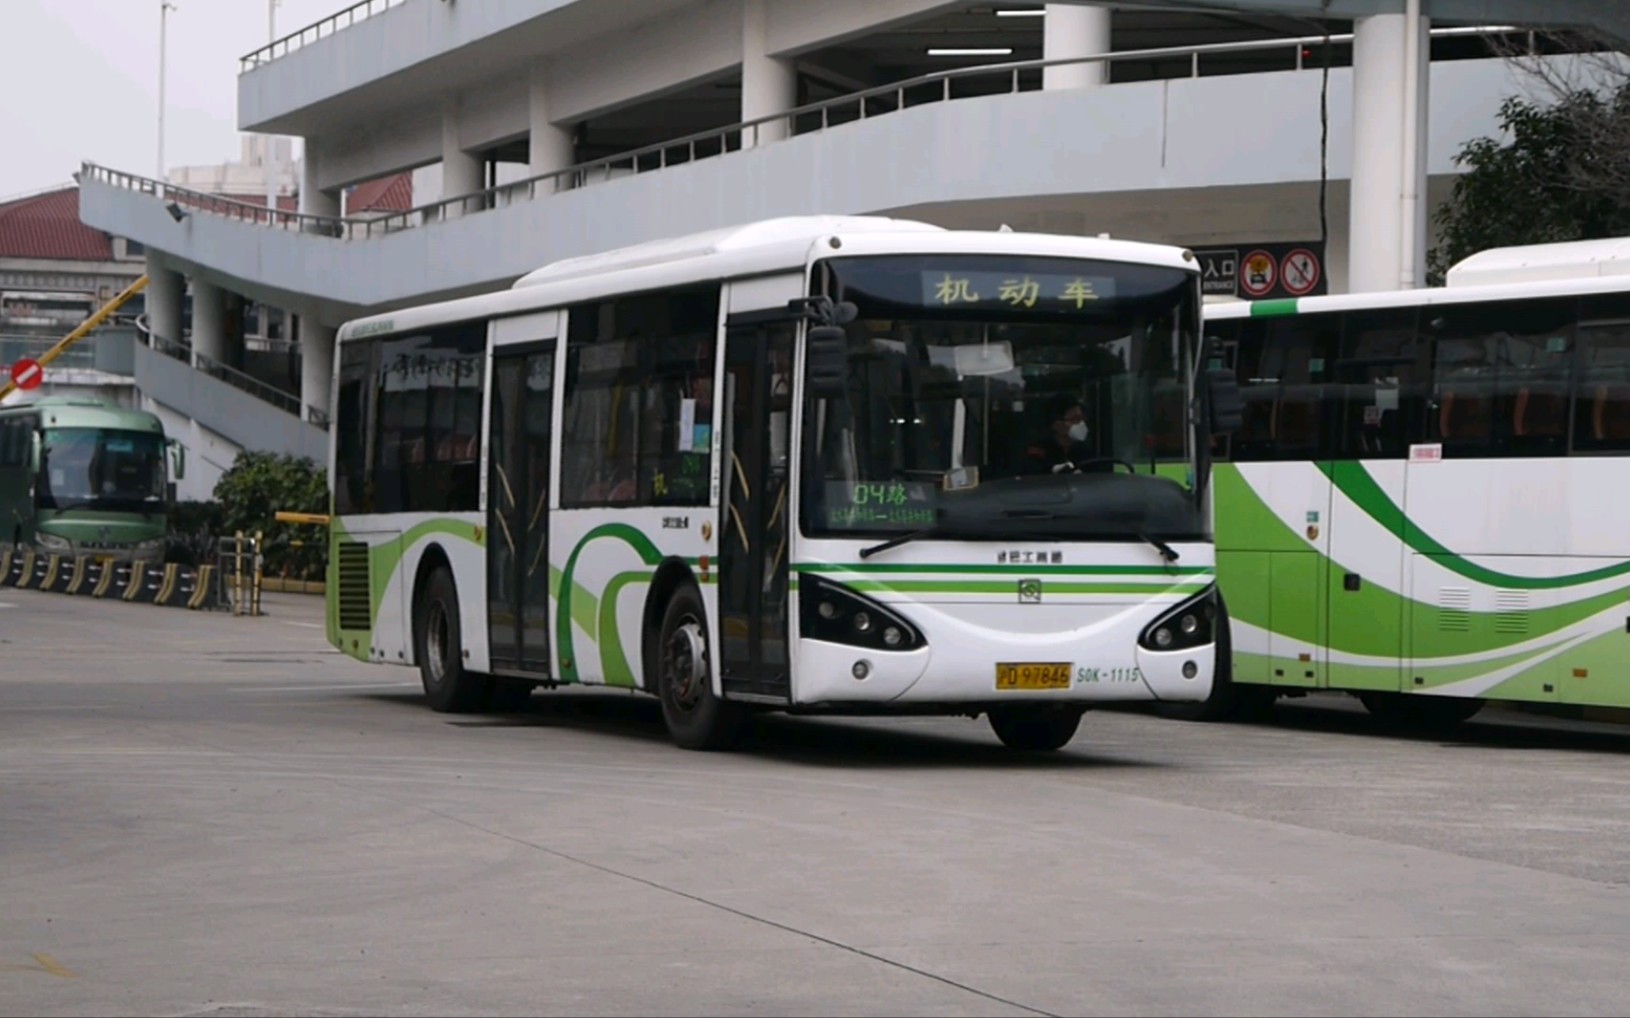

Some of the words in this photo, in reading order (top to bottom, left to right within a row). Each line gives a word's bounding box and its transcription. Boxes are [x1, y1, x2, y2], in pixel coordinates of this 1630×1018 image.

[1204, 258, 1235, 278] 入口
[935, 273, 1100, 309] 机动车
